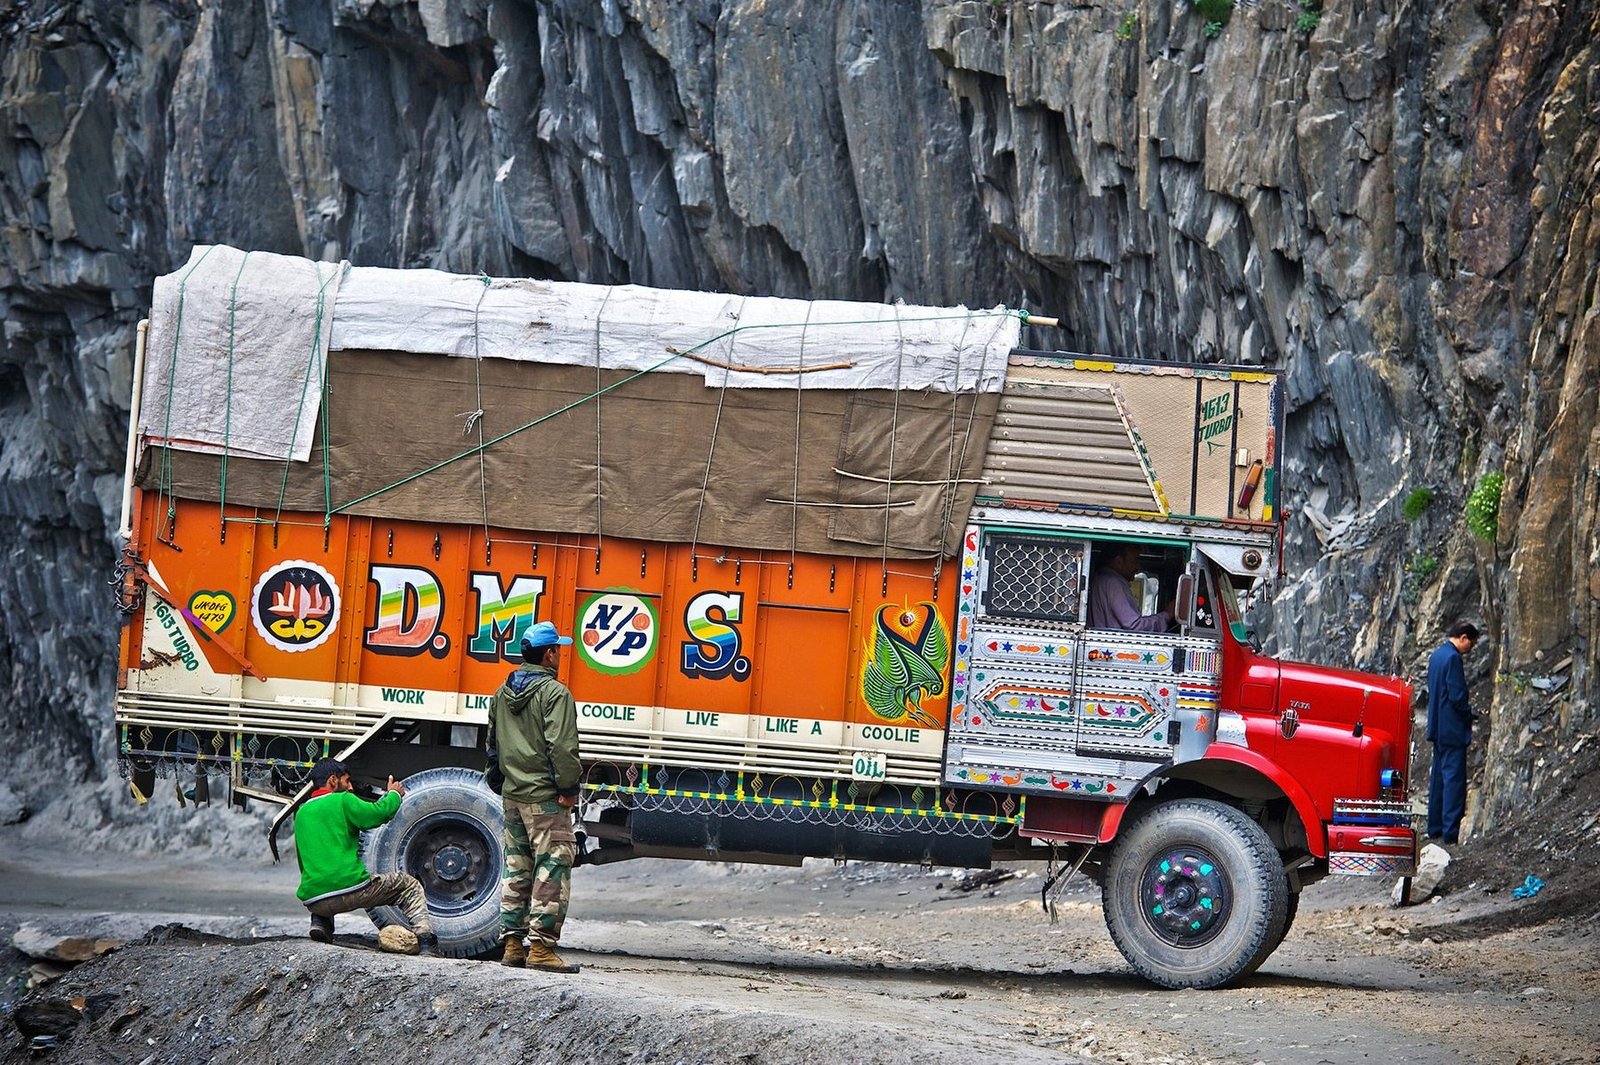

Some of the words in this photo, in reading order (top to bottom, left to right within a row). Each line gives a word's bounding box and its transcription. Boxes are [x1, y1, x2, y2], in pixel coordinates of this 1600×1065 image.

[1202, 392, 1230, 421] 1613
[1198, 415, 1233, 443] TURBO
[153, 600, 177, 630] 1613
[168, 626, 200, 672] TURBO
[199, 612, 225, 623] 1479
[362, 562, 452, 660] D.
[680, 590, 752, 683] S.
[381, 687, 425, 705] WORK
[582, 704, 636, 721] COOLIE
[686, 711, 719, 727] LIVE
[766, 717, 799, 733] LIKE
[811, 721, 823, 735] A
[862, 726, 920, 743] COOLIE
